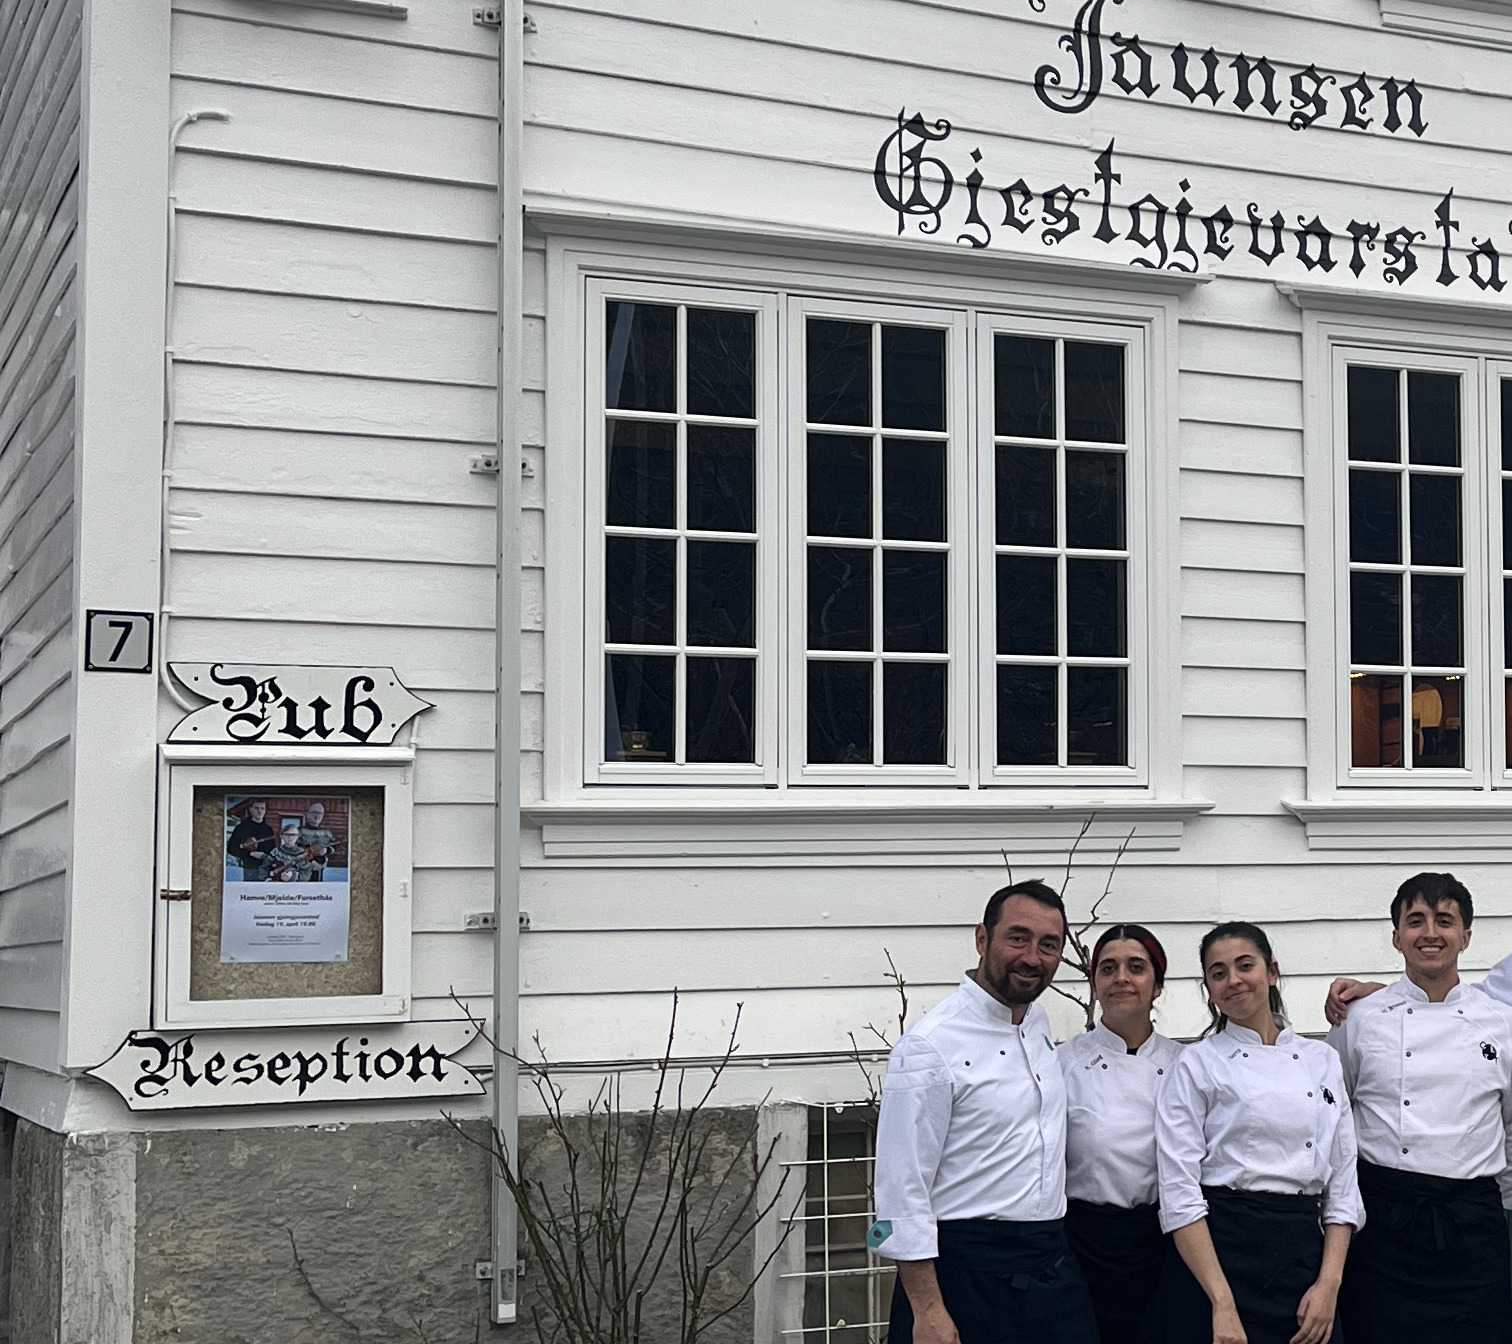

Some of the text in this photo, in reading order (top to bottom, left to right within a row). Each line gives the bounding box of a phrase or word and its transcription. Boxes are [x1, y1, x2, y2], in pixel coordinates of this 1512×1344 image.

[108, 620, 134, 662] 7
[210, 662, 384, 743] Pub
[128, 1030, 447, 1097] Reseption
